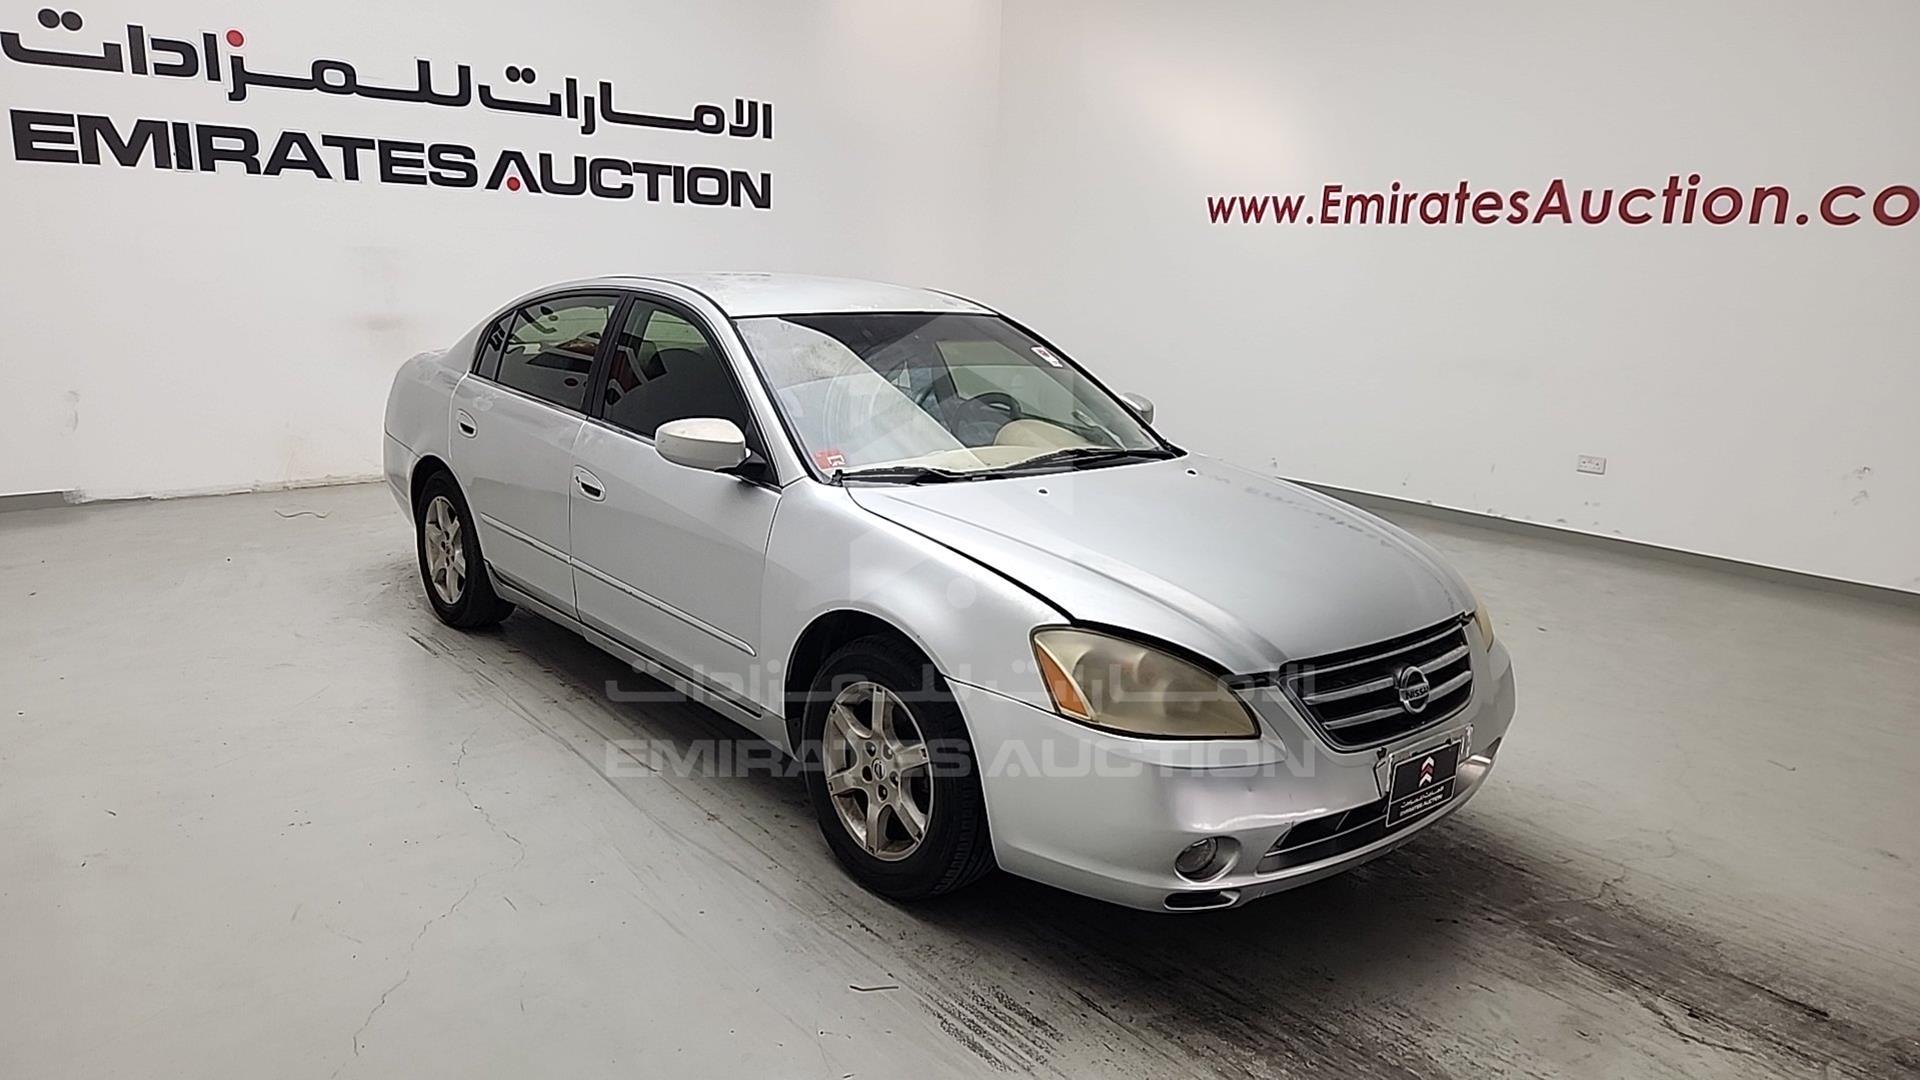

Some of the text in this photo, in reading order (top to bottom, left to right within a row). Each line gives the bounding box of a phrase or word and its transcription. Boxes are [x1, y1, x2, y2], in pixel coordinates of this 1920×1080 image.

[0, 8, 472, 107] للمزادات
[9, 109, 773, 209] EMIRATES AUCTION
